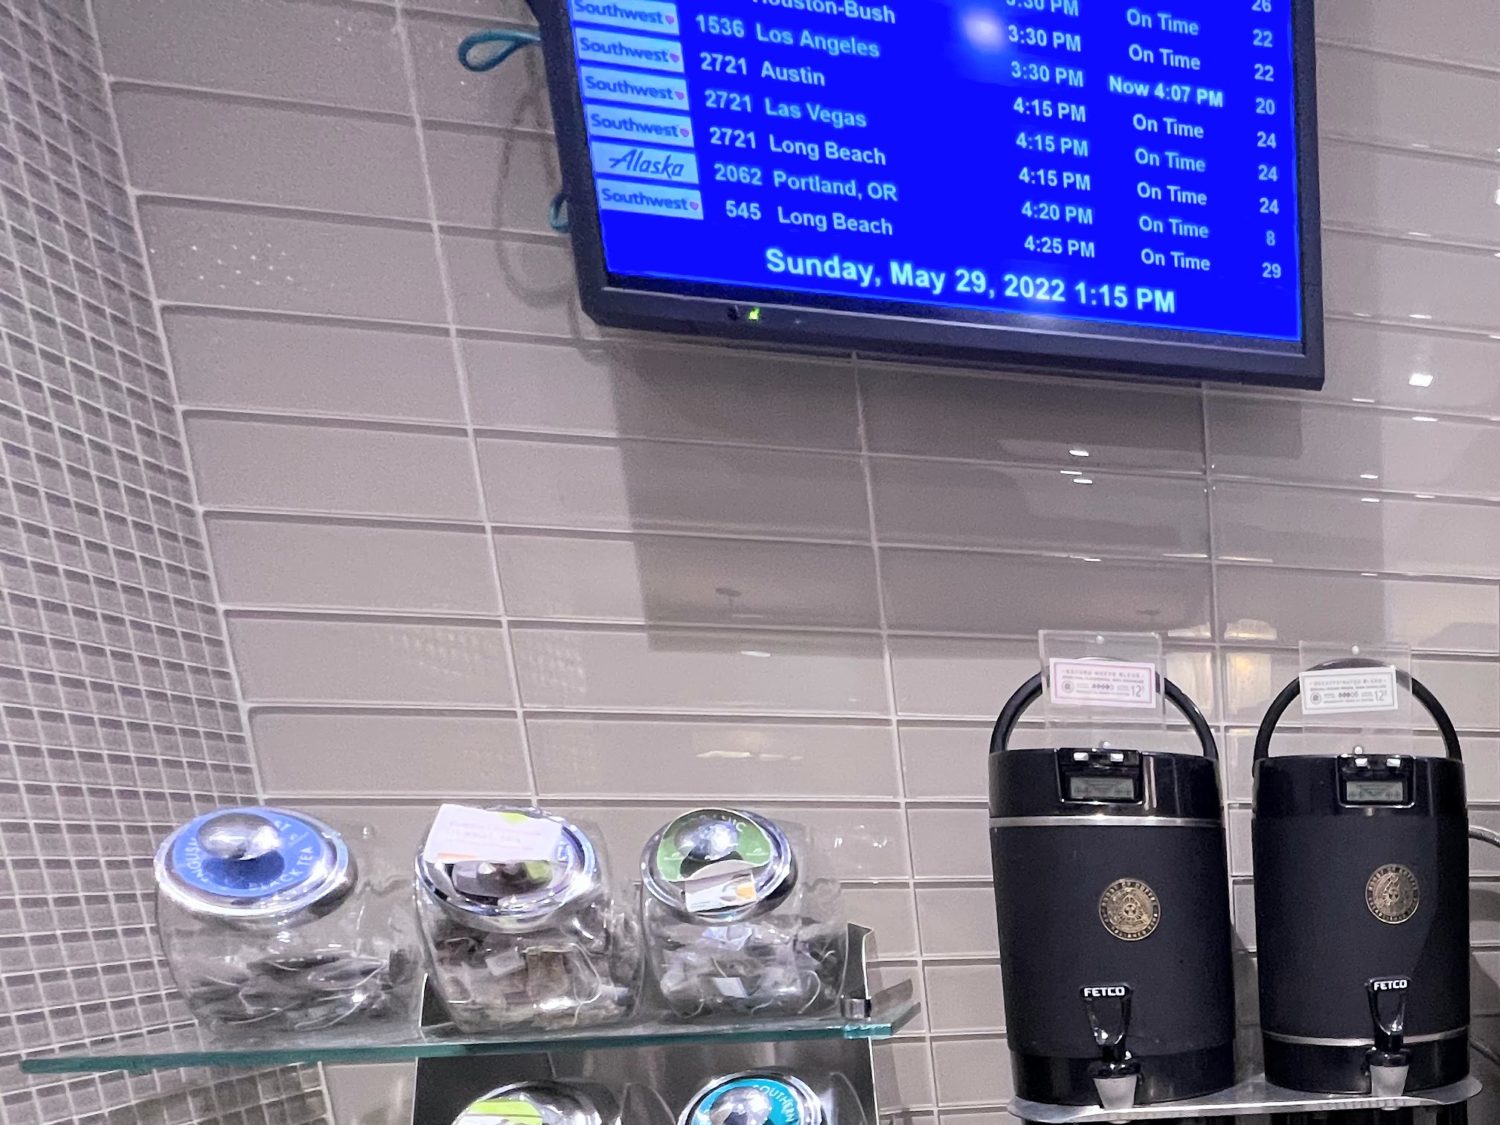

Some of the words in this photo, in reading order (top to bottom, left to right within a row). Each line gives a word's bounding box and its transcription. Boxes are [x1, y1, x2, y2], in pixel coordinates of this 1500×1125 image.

[1050, 0, 1078, 16] PM
[1127, 9, 1152, 28] On
[1157, 13, 1198, 35] Time
[1253, 29, 1272, 47] 22
[1252, 0, 1271, 12] 26
[574, 1, 664, 25] Southwest
[696, 15, 744, 37] 1536
[756, 23, 793, 44] Los
[800, 30, 879, 57] Angeles
[1011, 61, 1049, 82] 3:30
[1056, 67, 1083, 87] PM
[1109, 75, 1149, 96] Now
[1154, 83, 1191, 102] 4:07
[1197, 88, 1223, 107] PM
[1256, 98, 1275, 114] 20
[1008, 25, 1047, 46] 3:30
[1053, 32, 1081, 52] PM
[1129, 44, 1153, 63] On
[1159, 48, 1200, 70] Time
[1255, 64, 1273, 81] 22
[579, 37, 669, 62] Southwest
[701, 52, 746, 74] 2721
[761, 61, 825, 86] Austin
[1014, 97, 1052, 117] 4:15
[1058, 103, 1085, 122] PM
[1133, 114, 1157, 132] On
[1163, 118, 1203, 138] Time
[1257, 131, 1276, 148] 24
[585, 75, 674, 100] Southwest
[705, 90, 751, 112] 2721
[765, 98, 801, 118] Las
[806, 103, 866, 128] Vegas
[1016, 132, 1055, 152] 4:15
[1060, 137, 1088, 156] PM
[1135, 148, 1159, 166] On
[1165, 152, 1205, 171] Time
[1259, 165, 1277, 181] 24
[590, 114, 679, 138] Southwest
[710, 127, 755, 148] 2721
[770, 134, 819, 160] Long
[825, 141, 885, 165] Beach
[1019, 167, 1057, 186] 4:15
[1063, 172, 1090, 190] PM
[1137, 182, 1161, 199] On
[1167, 186, 1207, 205] Time
[1260, 198, 1279, 214] 24
[608, 149, 684, 179] Alaska
[714, 163, 762, 185] 2062
[774, 171, 862, 199] Portland,
[868, 182, 897, 201] OR
[1022, 201, 1060, 220] 4:20
[1065, 206, 1092, 224] PM
[1139, 216, 1163, 232] On
[1169, 219, 1208, 238] Time
[1267, 231, 1275, 245] 8
[601, 188, 689, 212] Southwest
[726, 200, 761, 220] 545
[778, 207, 827, 231] Long
[833, 213, 892, 235] Beach
[1025, 235, 1062, 254] 4:25
[1068, 240, 1094, 257] PM
[1141, 249, 1165, 266] On
[1171, 252, 1210, 270] Time
[1263, 262, 1281, 278] 29
[766, 248, 881, 287] Sunday,
[890, 261, 945, 295] May
[955, 268, 995, 298] 29,
[1004, 274, 1066, 304] 2022
[1075, 281, 1128, 308] 1:15
[1136, 288, 1175, 313] PM
[1084, 987, 1125, 997] FETCO
[1373, 979, 1408, 990] FETCO
